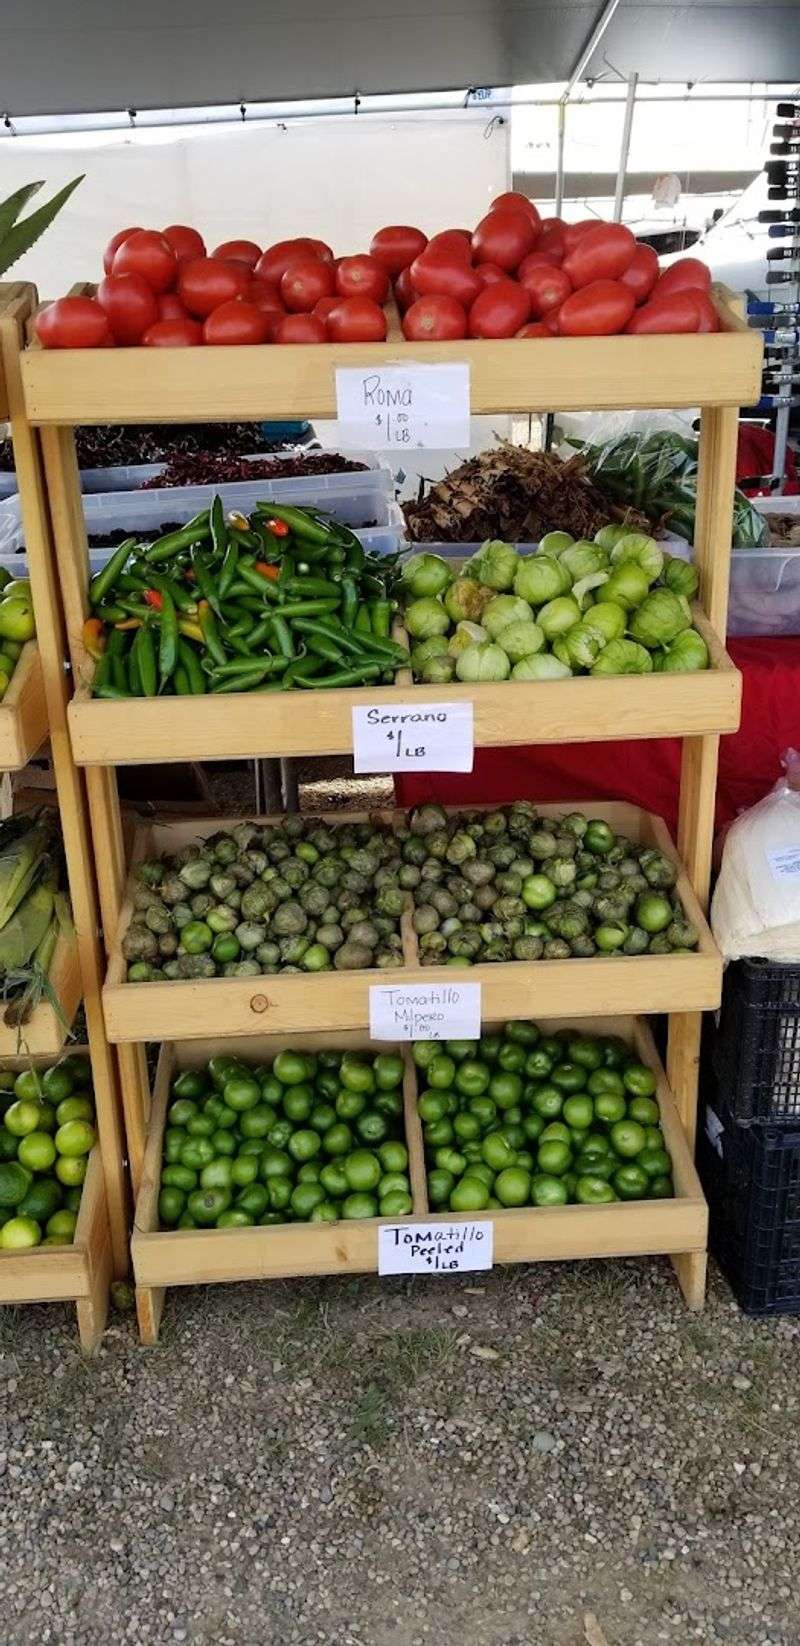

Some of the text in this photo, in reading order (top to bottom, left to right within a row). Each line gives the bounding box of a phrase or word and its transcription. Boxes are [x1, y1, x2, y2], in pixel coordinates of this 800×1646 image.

[367, 709, 447, 724] Serrano
[386, 730, 426, 757] $1 LB
[411, 1241, 465, 1257] Peeled
[441, 1260, 459, 1269] LB
